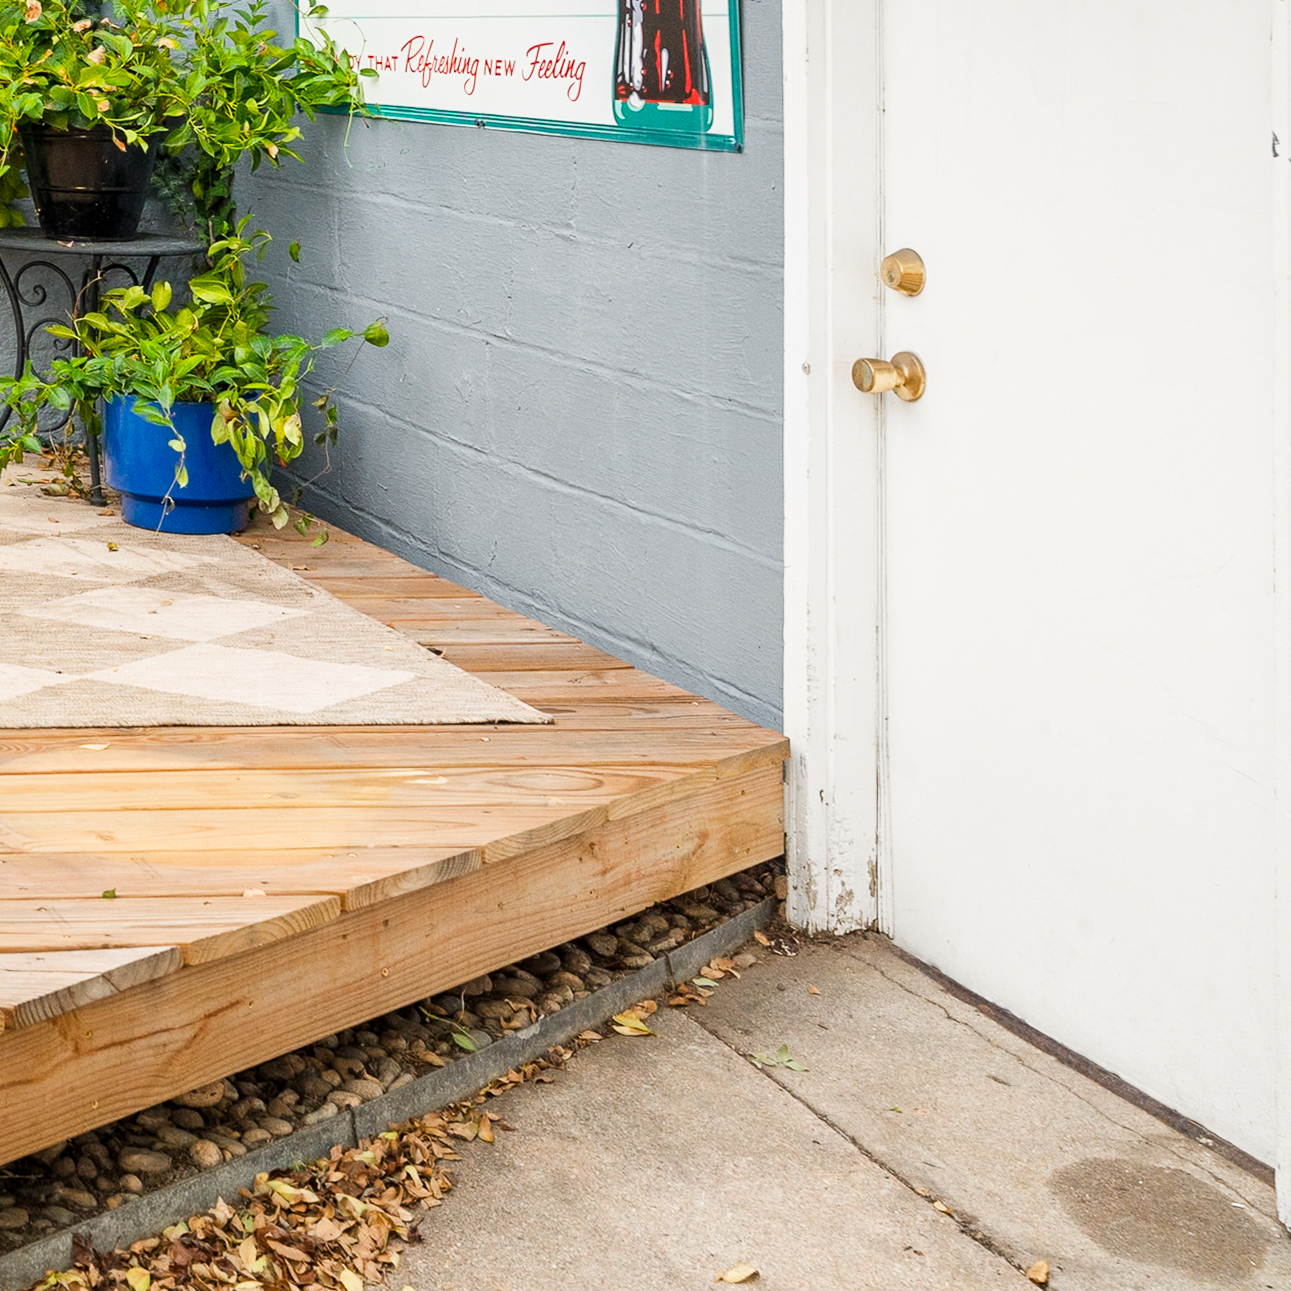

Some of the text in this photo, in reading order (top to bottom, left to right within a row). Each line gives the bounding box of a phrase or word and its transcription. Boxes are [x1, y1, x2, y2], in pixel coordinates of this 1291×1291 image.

[367, 55, 399, 72] THAT
[400, 35, 480, 96] Refreshing
[483, 58, 517, 77] NEW
[521, 40, 587, 102] Feeling
